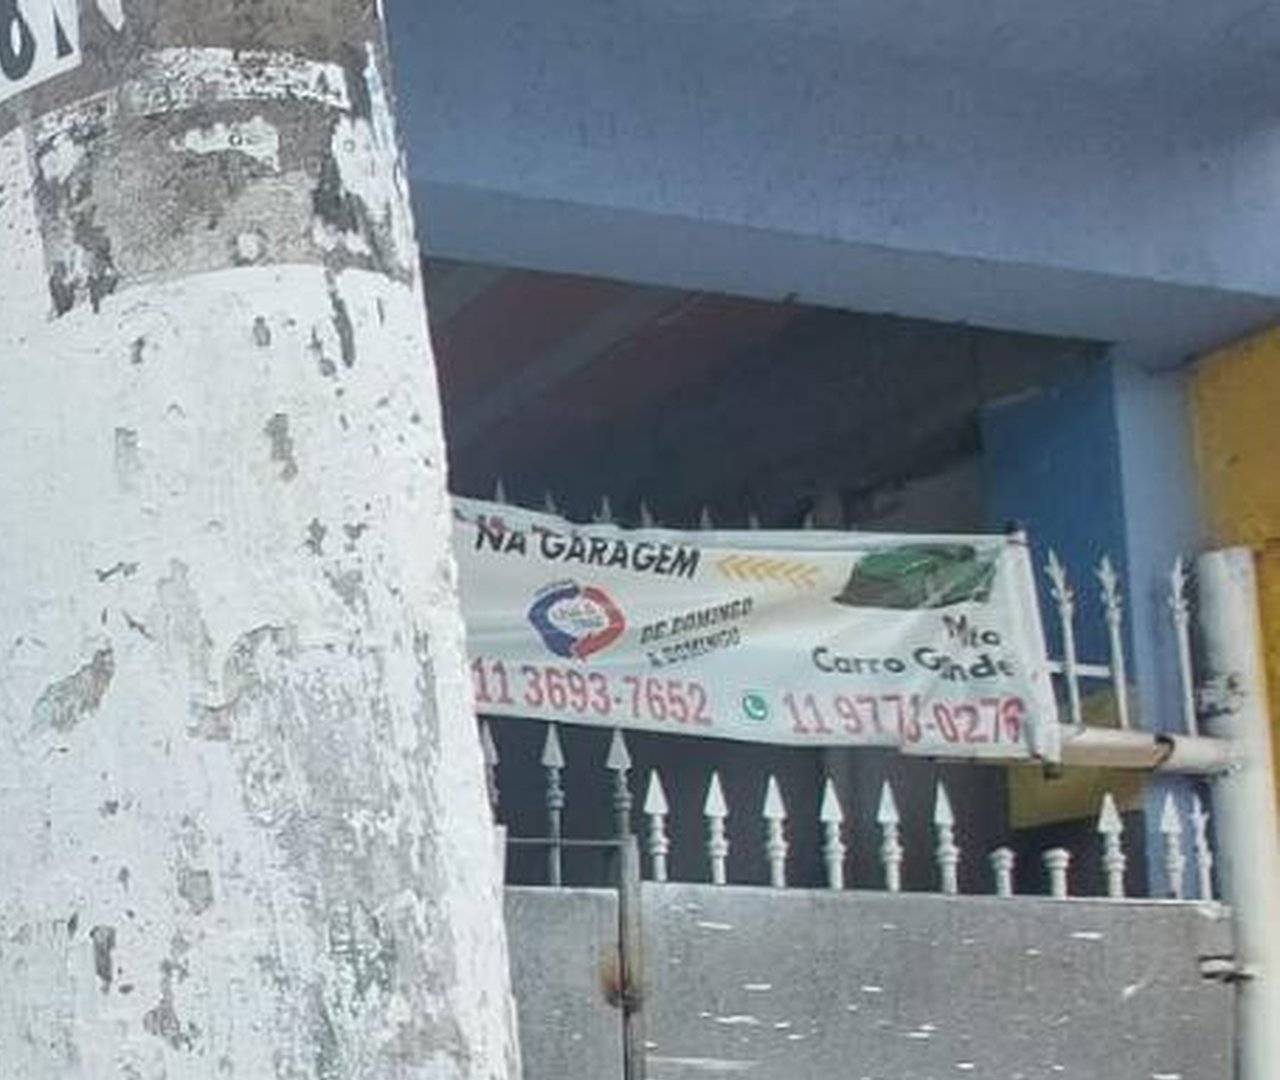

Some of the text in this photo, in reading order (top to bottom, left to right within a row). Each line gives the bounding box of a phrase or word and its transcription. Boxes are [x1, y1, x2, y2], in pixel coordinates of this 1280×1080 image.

[475, 515, 700, 578] NA GARAGEM
[812, 646, 906, 674] Carro
[521, 665, 713, 726] 3693-7652
[783, 690, 833, 735] 11
